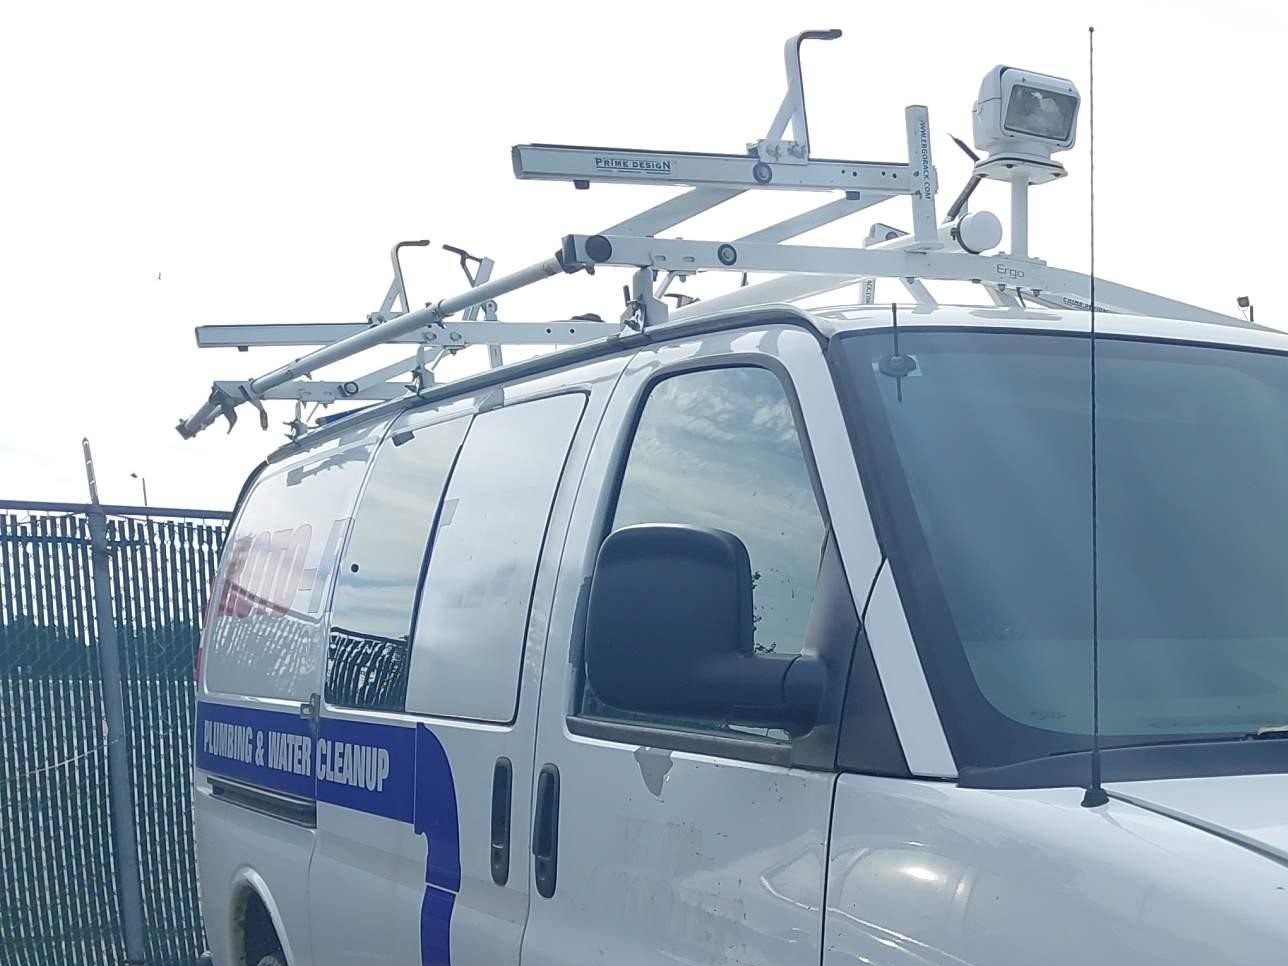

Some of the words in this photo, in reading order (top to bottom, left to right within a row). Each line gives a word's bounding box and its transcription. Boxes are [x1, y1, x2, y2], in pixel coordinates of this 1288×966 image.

[594, 157, 629, 168] PRIME
[632, 160, 671, 170] DESIGN
[996, 263, 1025, 279] Ergo
[204, 719, 253, 764] PLUMBING
[255, 730, 265, 767] &
[268, 730, 312, 777] WATER
[316, 738, 390, 792] CLEANUP
